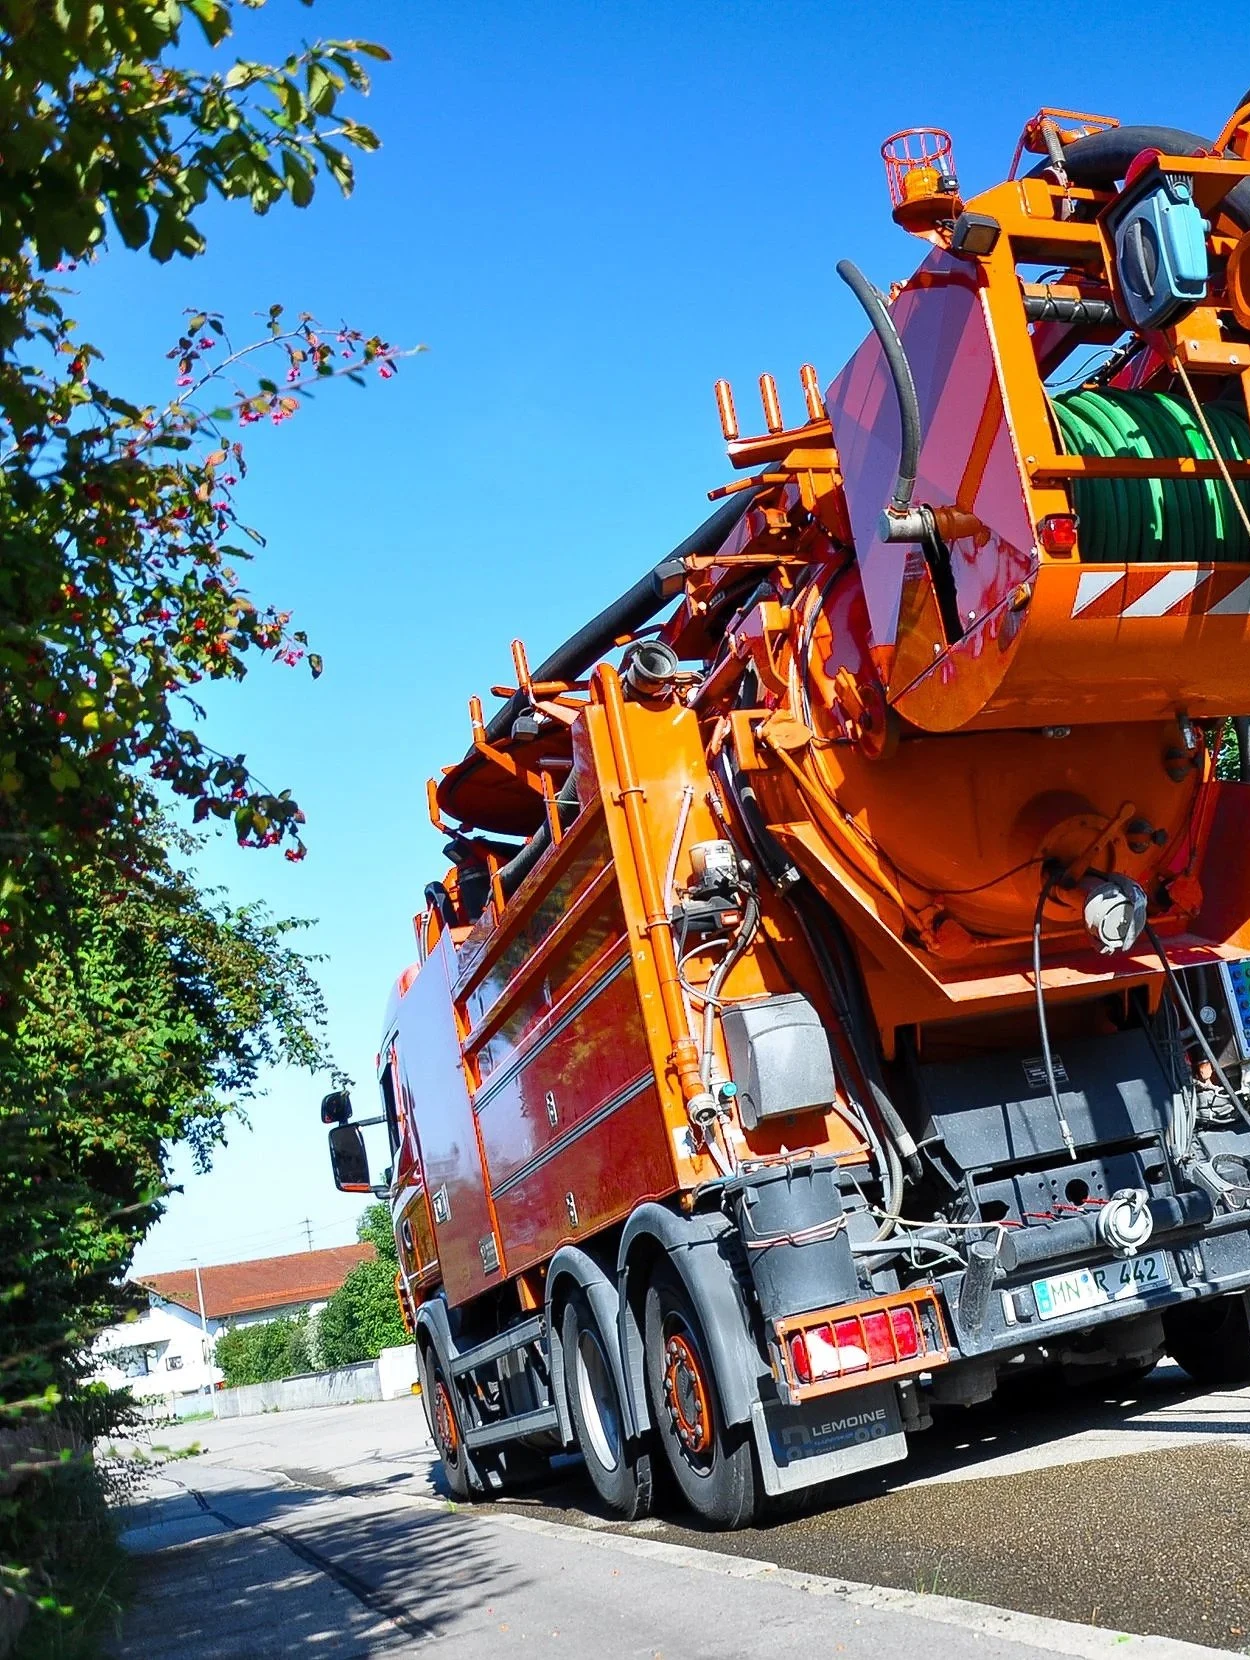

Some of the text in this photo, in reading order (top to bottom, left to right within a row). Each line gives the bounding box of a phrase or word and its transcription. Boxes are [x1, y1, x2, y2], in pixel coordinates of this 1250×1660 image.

[1051, 1278, 1080, 1306] MN
[1094, 1270, 1109, 1293] R
[1119, 1257, 1159, 1285] 442
[812, 1409, 886, 1436] LEMOINE
